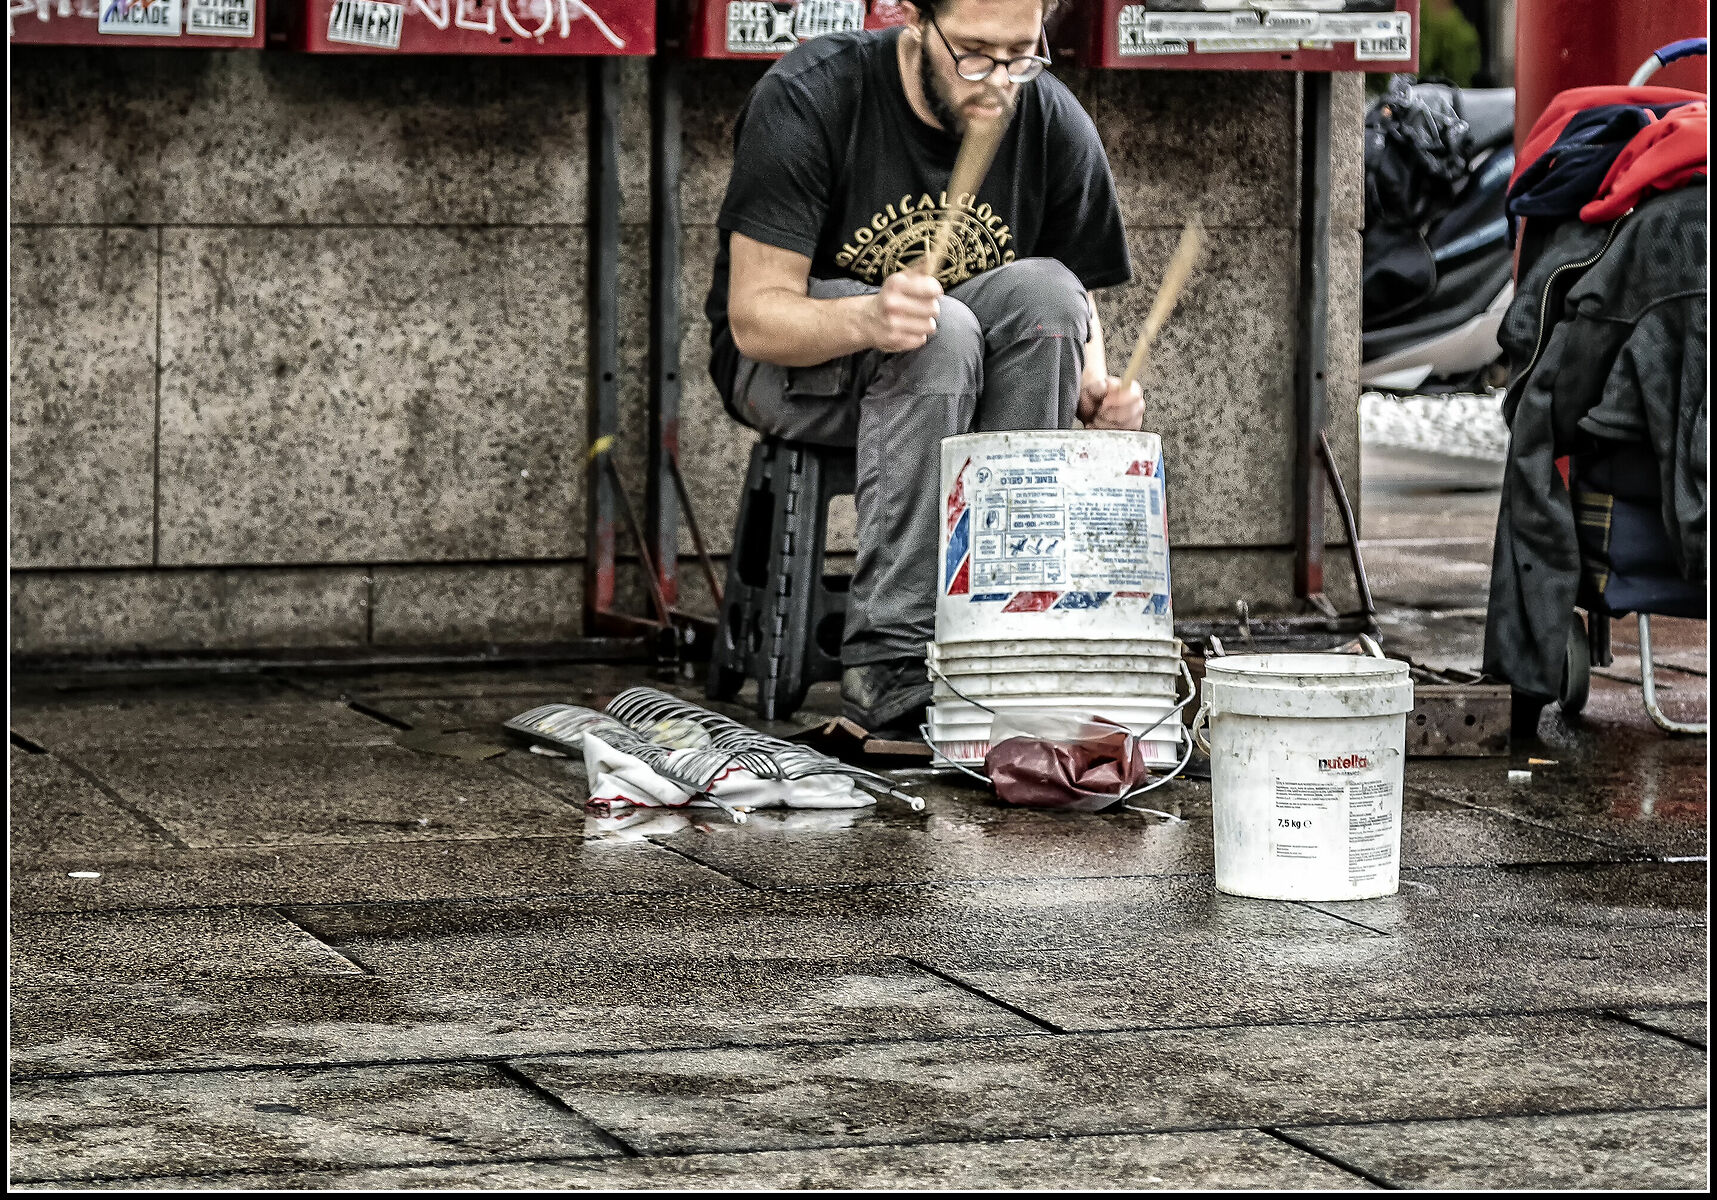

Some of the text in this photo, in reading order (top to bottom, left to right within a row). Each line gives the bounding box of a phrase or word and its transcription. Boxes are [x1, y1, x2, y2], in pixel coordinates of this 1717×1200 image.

[111, 4, 169, 25] ARCADE
[1319, 755, 1367, 769] nutella
[1291, 818, 1301, 829] kg
